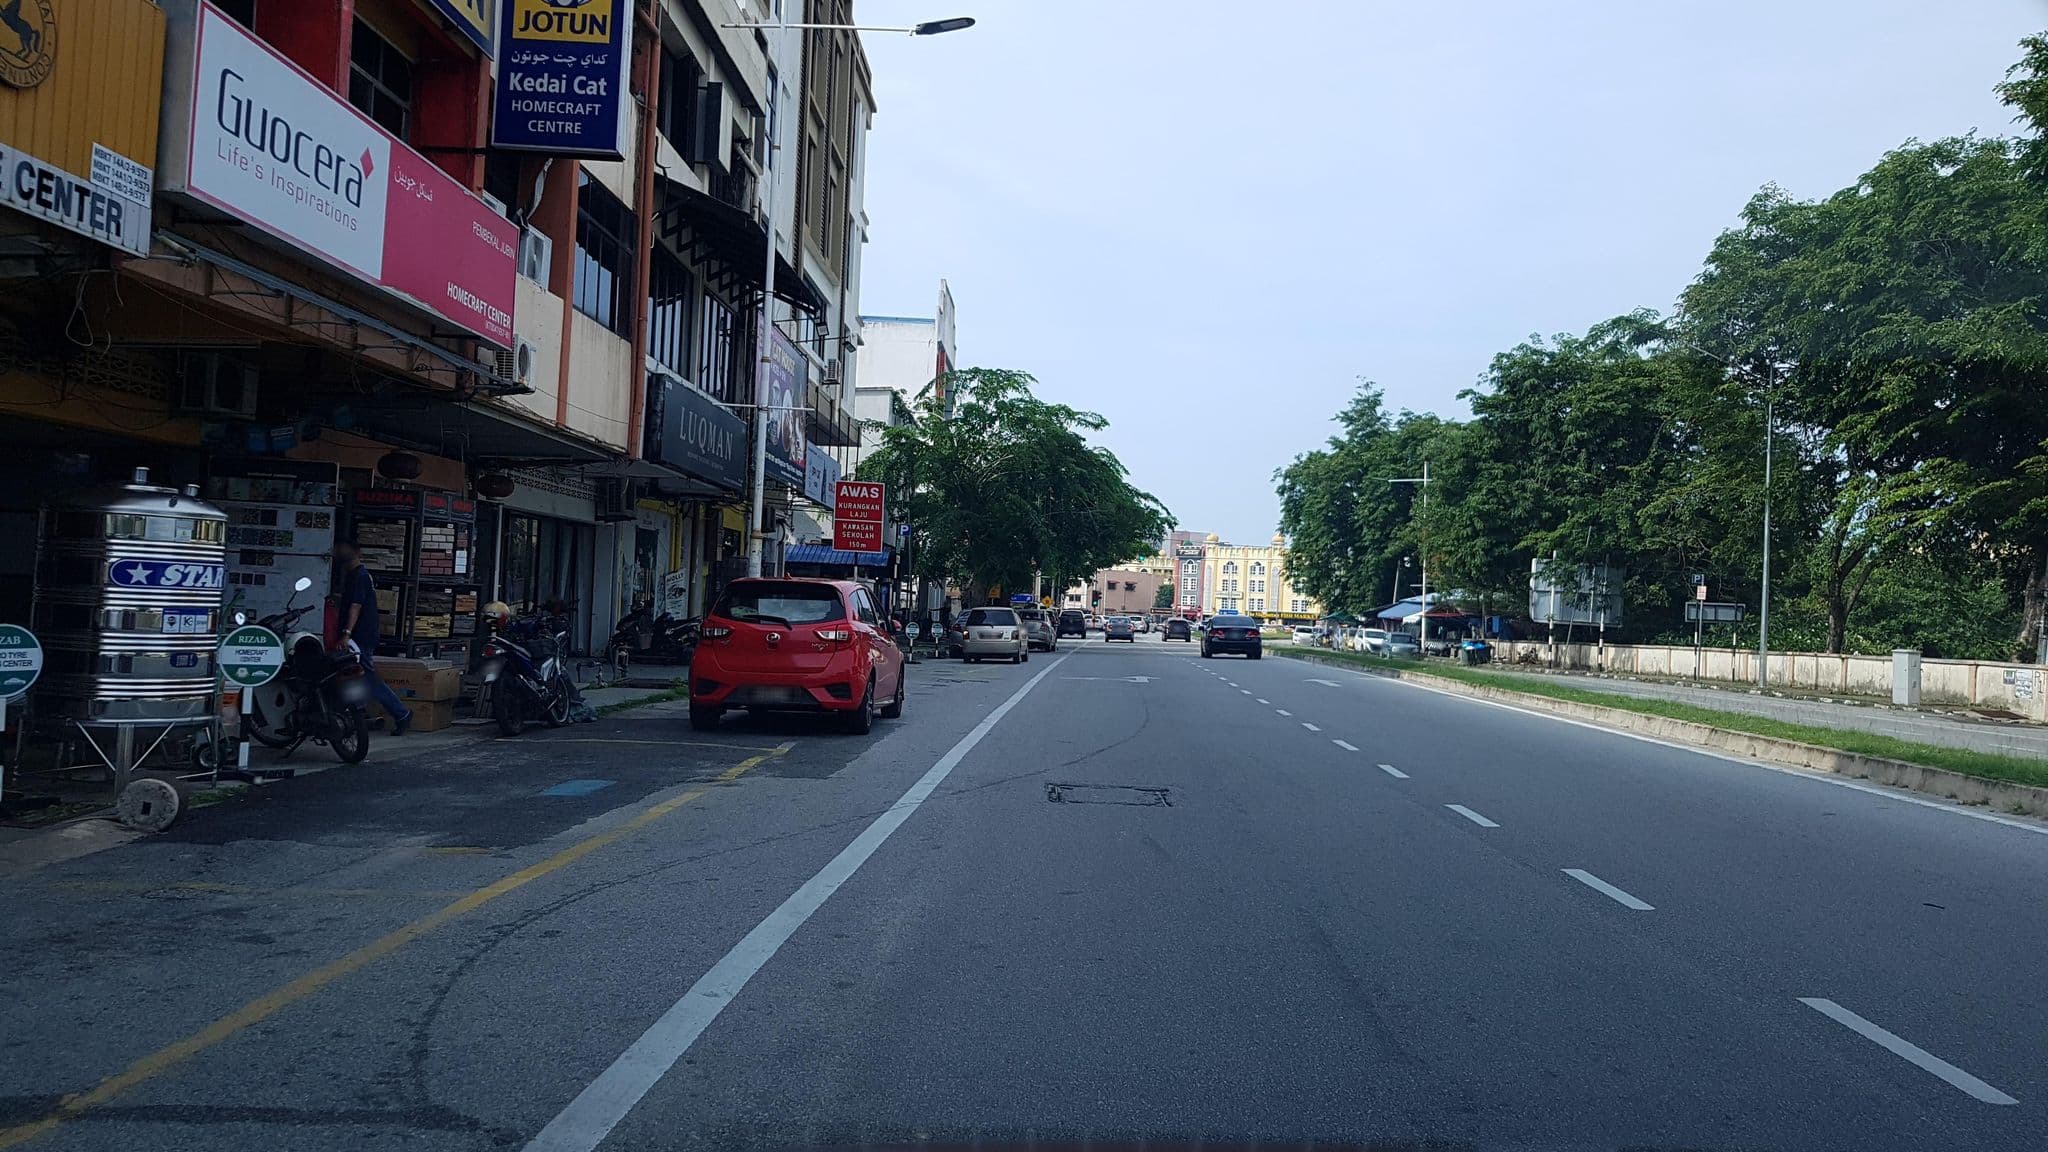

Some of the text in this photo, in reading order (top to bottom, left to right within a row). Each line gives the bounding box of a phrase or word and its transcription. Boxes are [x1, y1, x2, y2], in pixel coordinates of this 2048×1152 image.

[519, 10, 608, 36] JOTUN
[509, 72, 608, 96] Kedai Cat
[511, 100, 602, 116] HOMECRAFT
[528, 120, 582, 134] CENTRE
[218, 137, 358, 232] Life's Inspirations
[15, 160, 123, 238] CENTER
[472, 221, 499, 250] PEMBEKAL
[447, 281, 488, 317] HOMECRAFT
[488, 306, 511, 330] CENTER
[680, 406, 733, 460] LUQMAN
[840, 485, 879, 498] AWAS
[838, 502, 880, 511] KURANGKAN
[842, 523, 874, 531] KAWASAN
[900, 525, 909, 535] P
[842, 531, 874, 539] SEKOLAH
[160, 564, 224, 588] STAR
[238, 635, 267, 644] RIZAB
[8, 651, 28, 659] TYRE
[3, 659, 33, 667] CENTER
